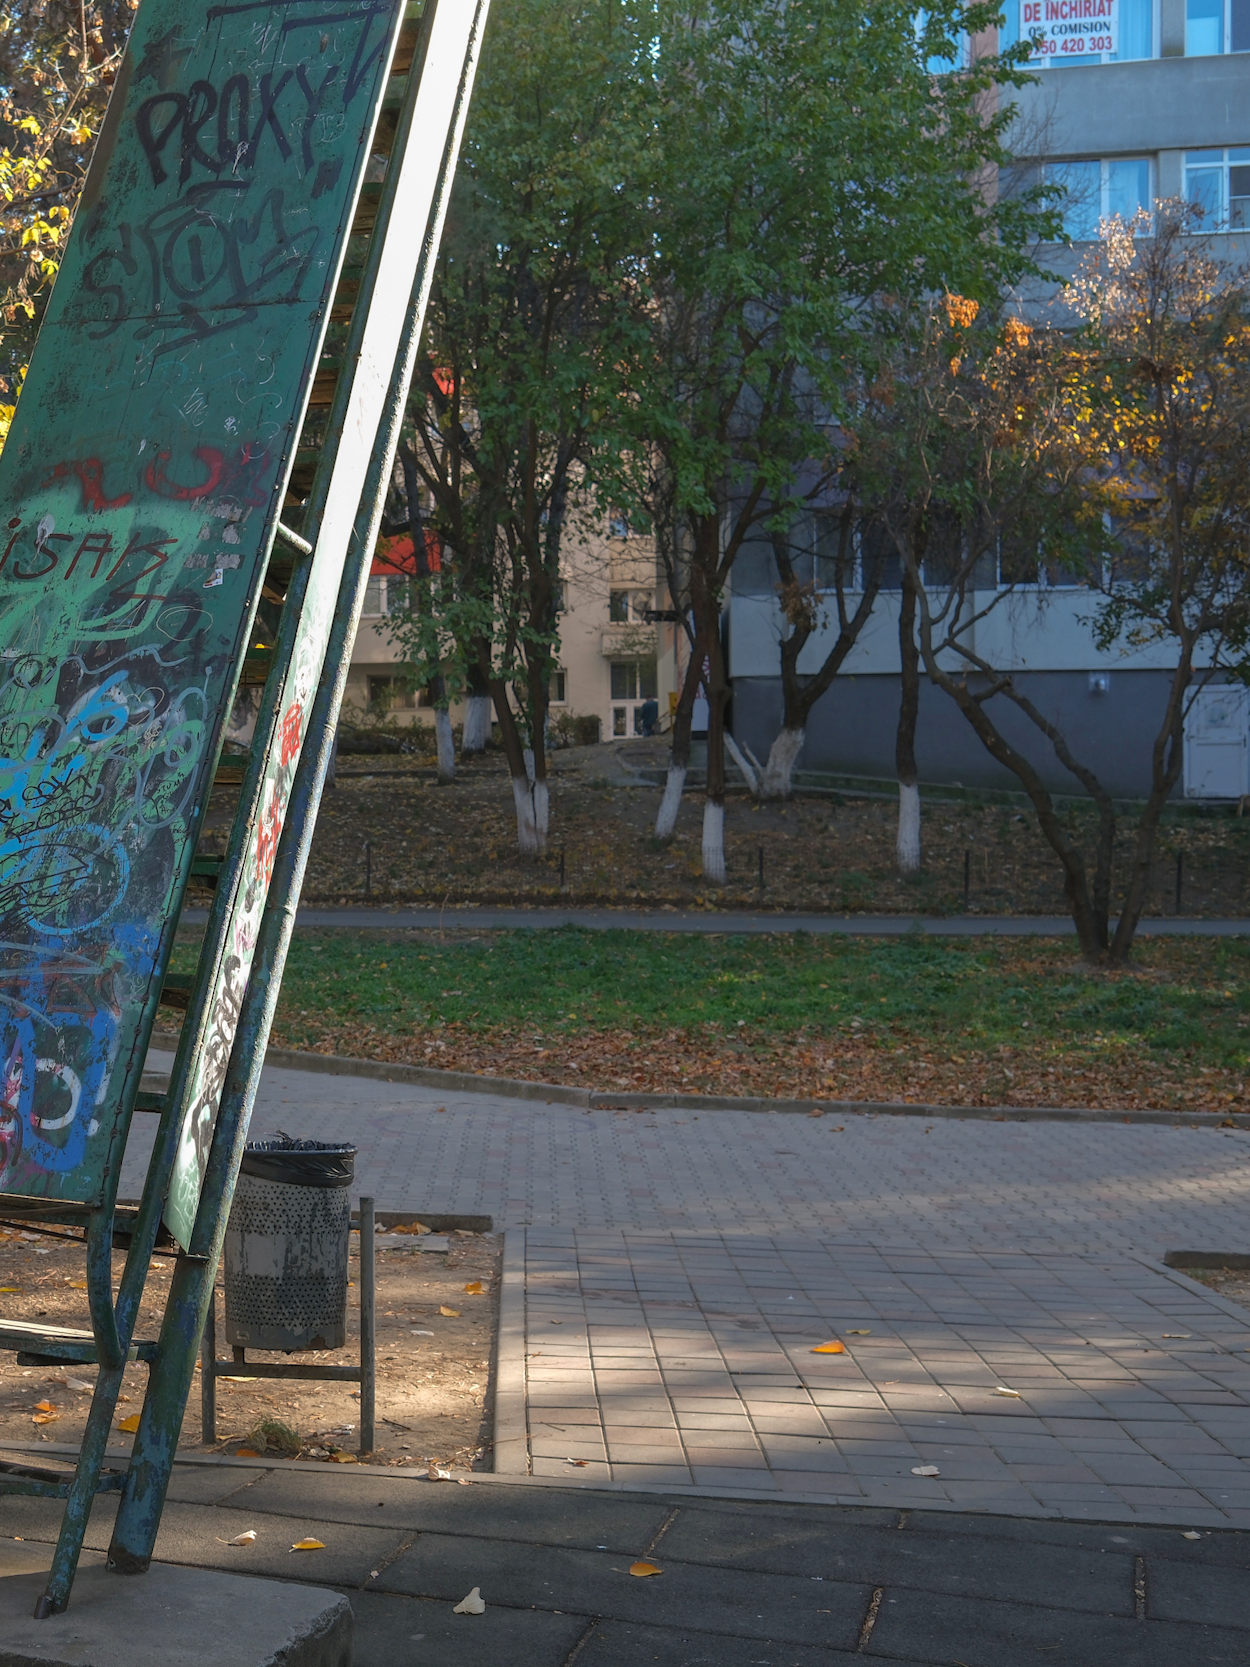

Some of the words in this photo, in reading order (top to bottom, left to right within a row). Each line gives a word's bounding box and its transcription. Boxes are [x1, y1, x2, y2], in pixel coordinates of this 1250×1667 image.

[1024, 3, 1041, 22] DE
[1051, 21, 1111, 36] COMISION
[1061, 38, 1085, 53] 420
[1089, 36, 1112, 51] 303
